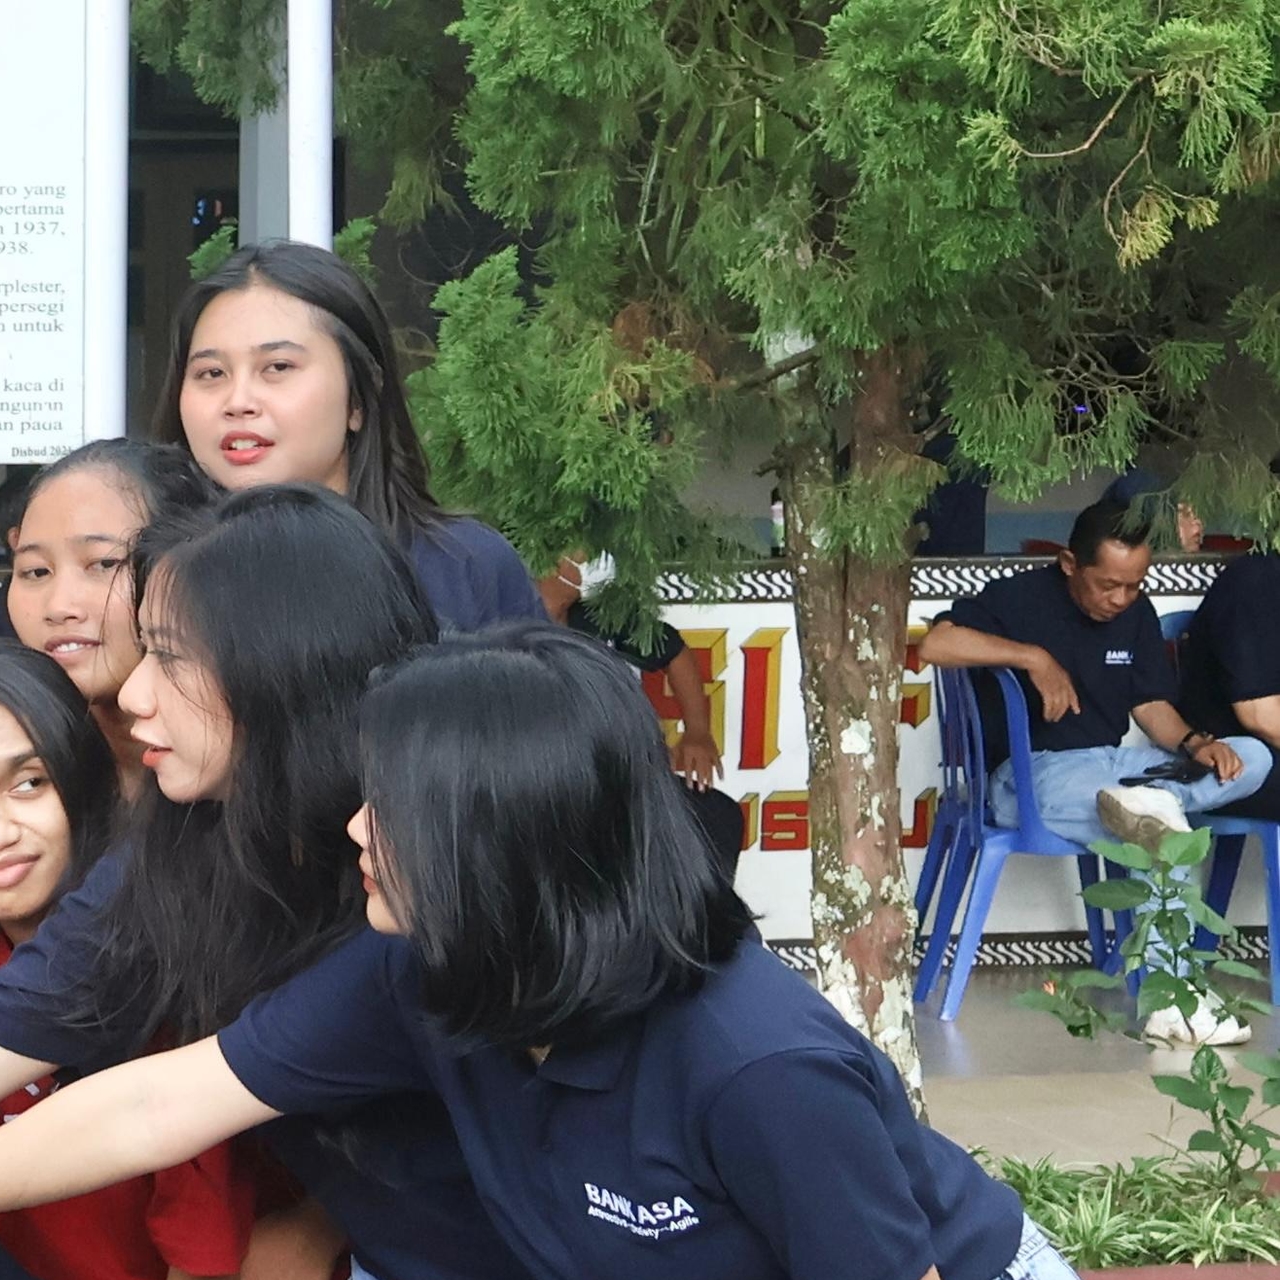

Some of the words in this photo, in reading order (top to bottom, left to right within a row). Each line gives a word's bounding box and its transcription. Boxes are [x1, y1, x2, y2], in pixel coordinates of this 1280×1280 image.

[22, 184, 67, 200] yang
[14, 220, 66, 236] 1937,
[12, 318, 65, 333] untuk
[2, 377, 43, 393] kaca
[47, 377, 65, 393] di
[11, 446, 47, 458] Disbud
[585, 1182, 637, 1222] BANK
[637, 1195, 695, 1226] ASA
